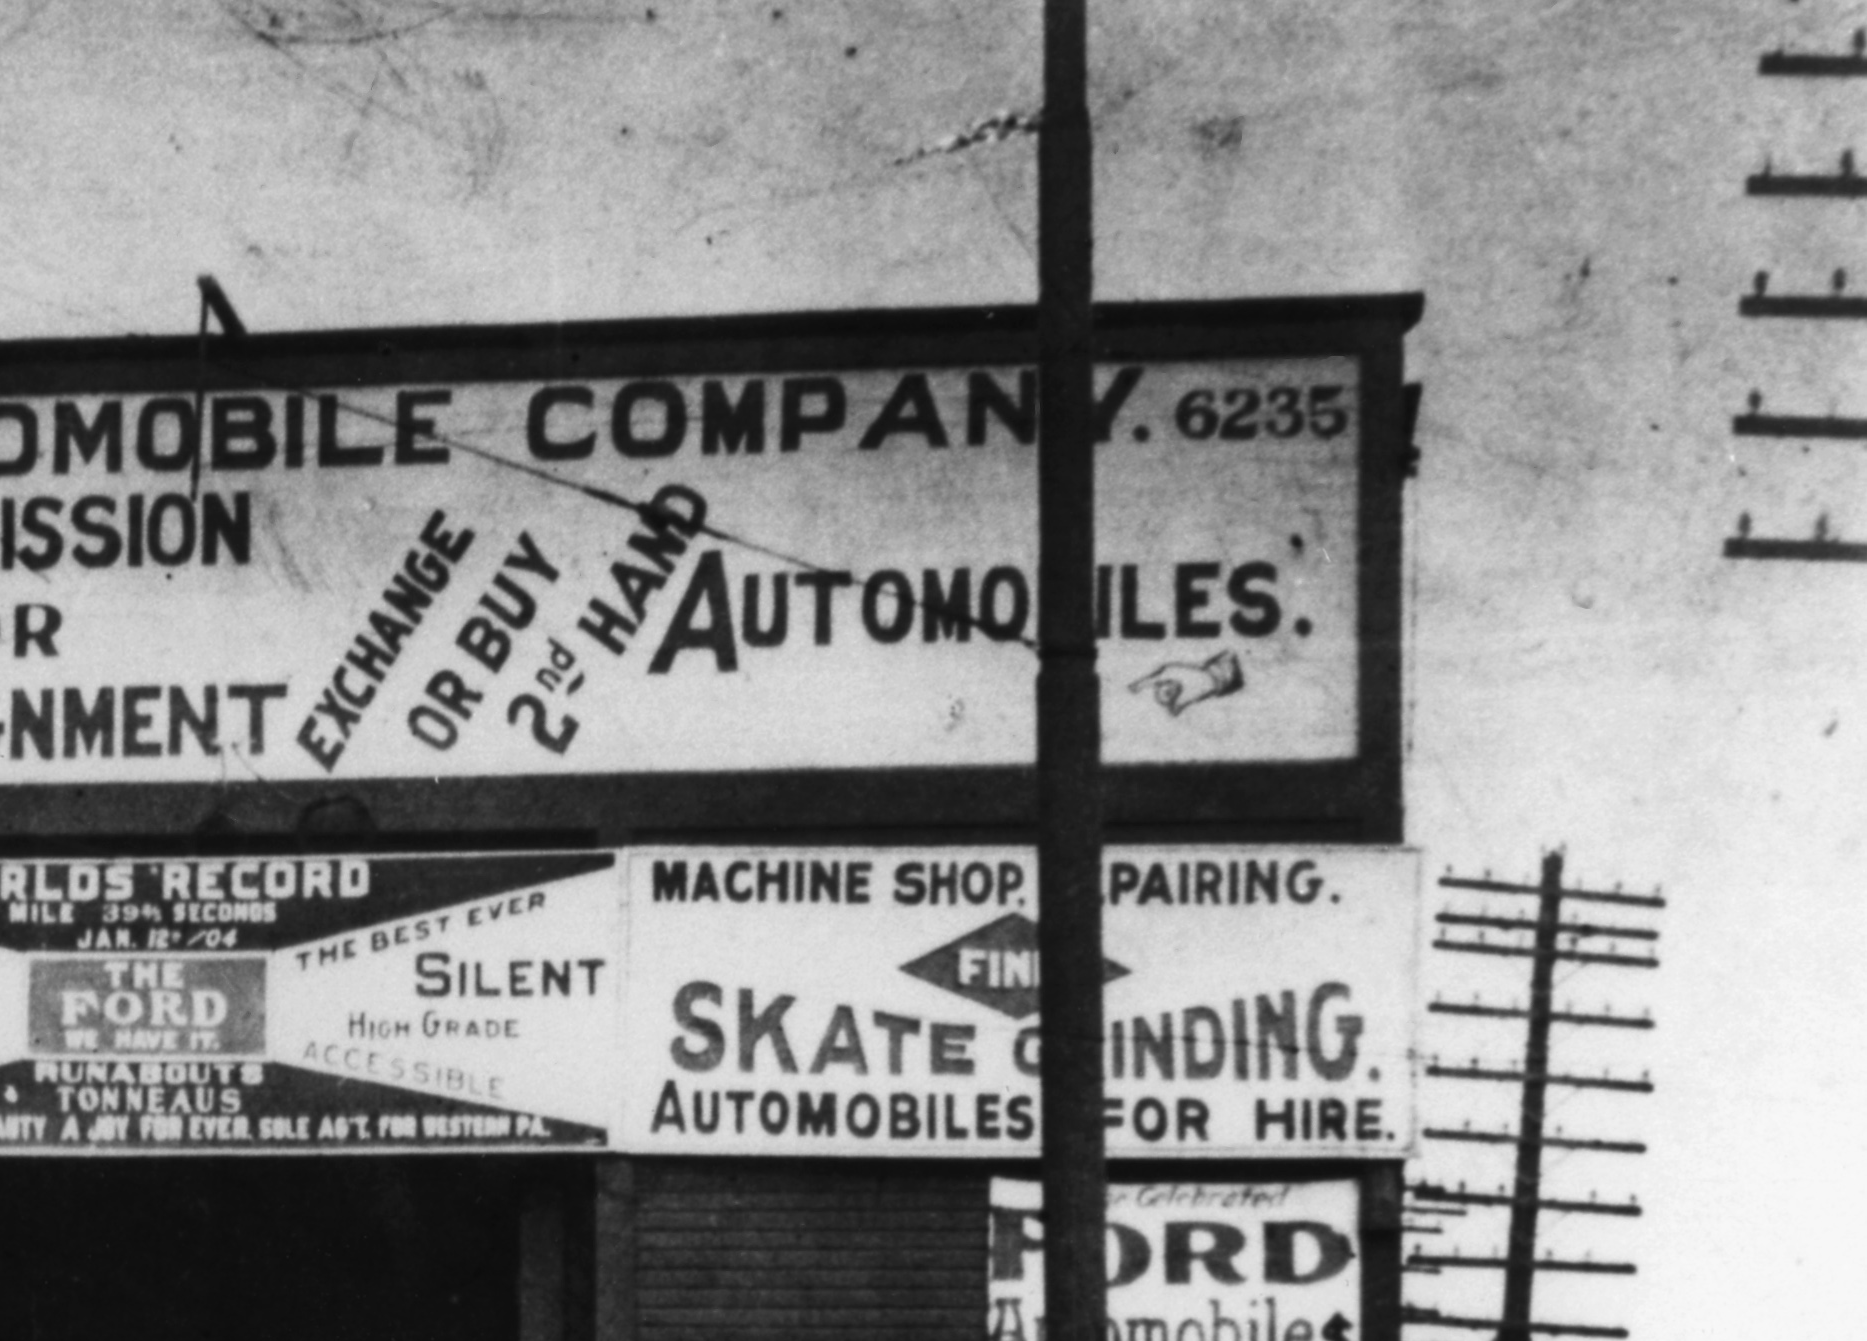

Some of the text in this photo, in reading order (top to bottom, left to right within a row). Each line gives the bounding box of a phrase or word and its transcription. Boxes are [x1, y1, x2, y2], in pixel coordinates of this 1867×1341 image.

[1175, 386, 1348, 441] 6235
[507, 484, 708, 756] 2nd HAND
[647, 550, 1313, 674] AUTOMOILES.
[296, 509, 475, 773] EXCHANGE
[407, 531, 560, 751] OR BUY
[163, 860, 371, 901] RECORD
[651, 860, 873, 904] MACHINE
[1101, 860, 1340, 905] PAIRING.
[9, 902, 74, 923] MILE
[173, 902, 277, 923] SECONDS
[296, 892, 546, 971] THE BEST EVER
[77, 929, 137, 950] JAN.
[103, 962, 184, 989] THE
[416, 952, 606, 998] SILENT
[60, 989, 228, 1026] FORD
[348, 1010, 520, 1039] HIGH GRADE
[670, 980, 976, 1076] SKATE
[64, 1029, 99, 1051] WE
[114, 1029, 178, 1050] HAVE
[34, 1061, 264, 1085] RUNABOUTS
[304, 1041, 504, 1100] ACCESSIBLE
[55, 1087, 241, 1114] TONNEAUS
[650, 1079, 1035, 1140] AUTOMOBILES
[1255, 1097, 1395, 1141] HIRE.
[60, 1115, 80, 1140] A
[86, 1115, 130, 1141] JOY
[259, 1115, 310, 1140] SOLE
[378, 1114, 417, 1138] FOR
[422, 1114, 511, 1138] WESTERN
